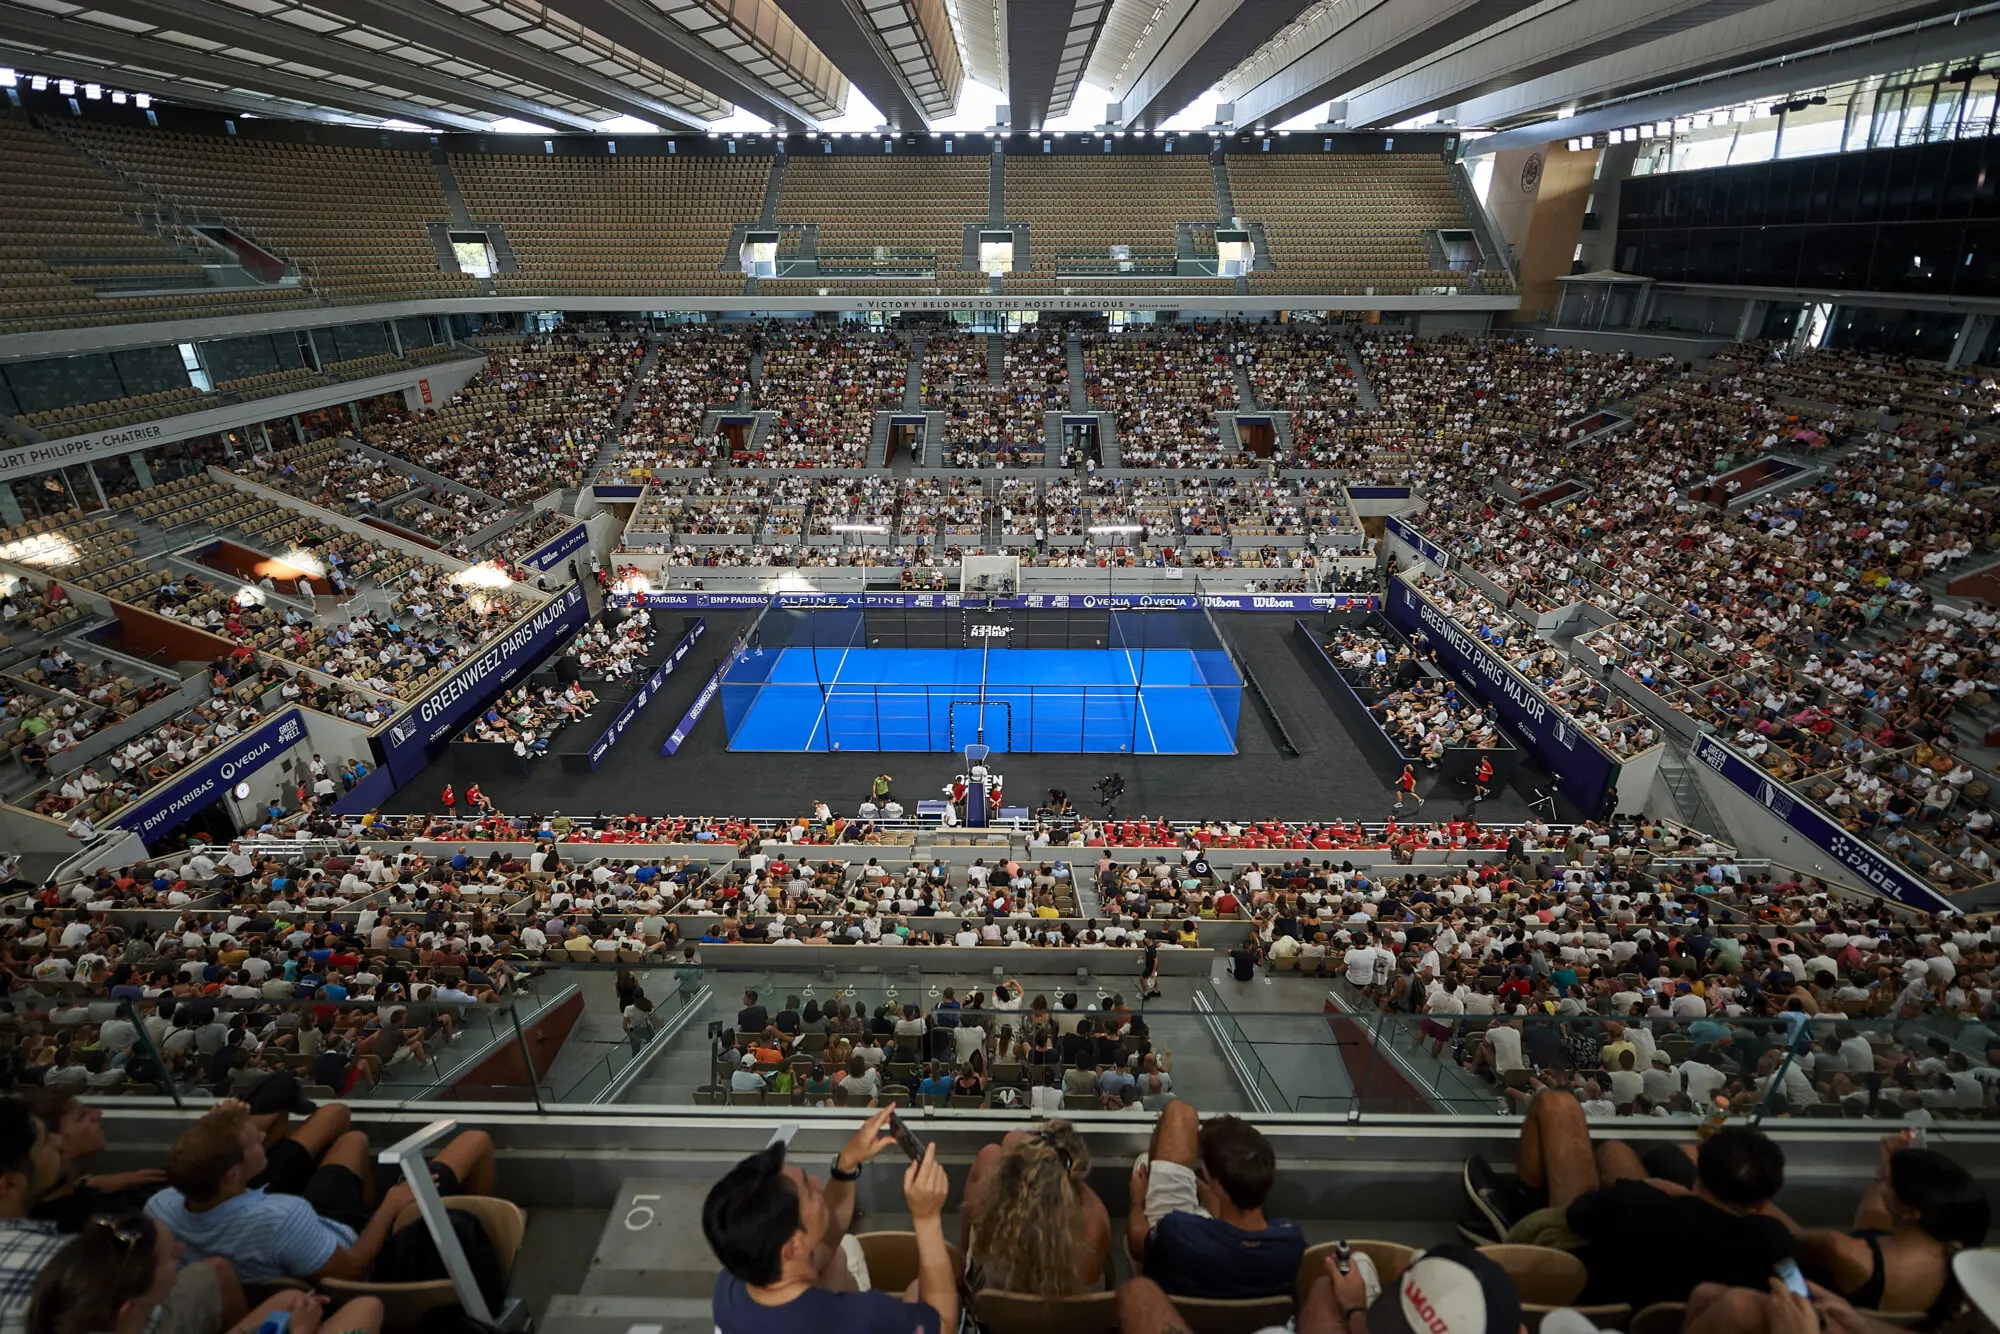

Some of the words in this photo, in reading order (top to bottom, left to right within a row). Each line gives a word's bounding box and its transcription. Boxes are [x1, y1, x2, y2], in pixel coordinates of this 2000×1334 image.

[30, 439, 93, 462] PHILIPPE
[102, 426, 161, 447] CHATRIER
[561, 531, 586, 552] ALPINE
[1096, 598, 1130, 606] VEOLIA
[1154, 598, 1187, 606] VEOLIA
[1203, 597, 1240, 608] Wilson
[1253, 597, 1294, 608] Wilson
[421, 648, 501, 722] GREENWEEZ
[501, 625, 532, 659] PARIS
[534, 598, 566, 634] MAJOR
[1420, 604, 1472, 660] GREENWEEZ
[1472, 649, 1504, 686] PARIS
[1503, 676, 1545, 724] MAJOR
[690, 688, 711, 720] GREENWEEZ
[278, 718, 298, 735] GREEN
[284, 727, 300, 742] WEEZ
[235, 742, 271, 769] VEOLIA
[1706, 755, 1722, 772] WEEZ
[1708, 744, 1727, 763] GREEN
[144, 810, 168, 831] BNP
[170, 779, 215, 814] PARIBAS
[1846, 853, 1903, 901] PADEL
